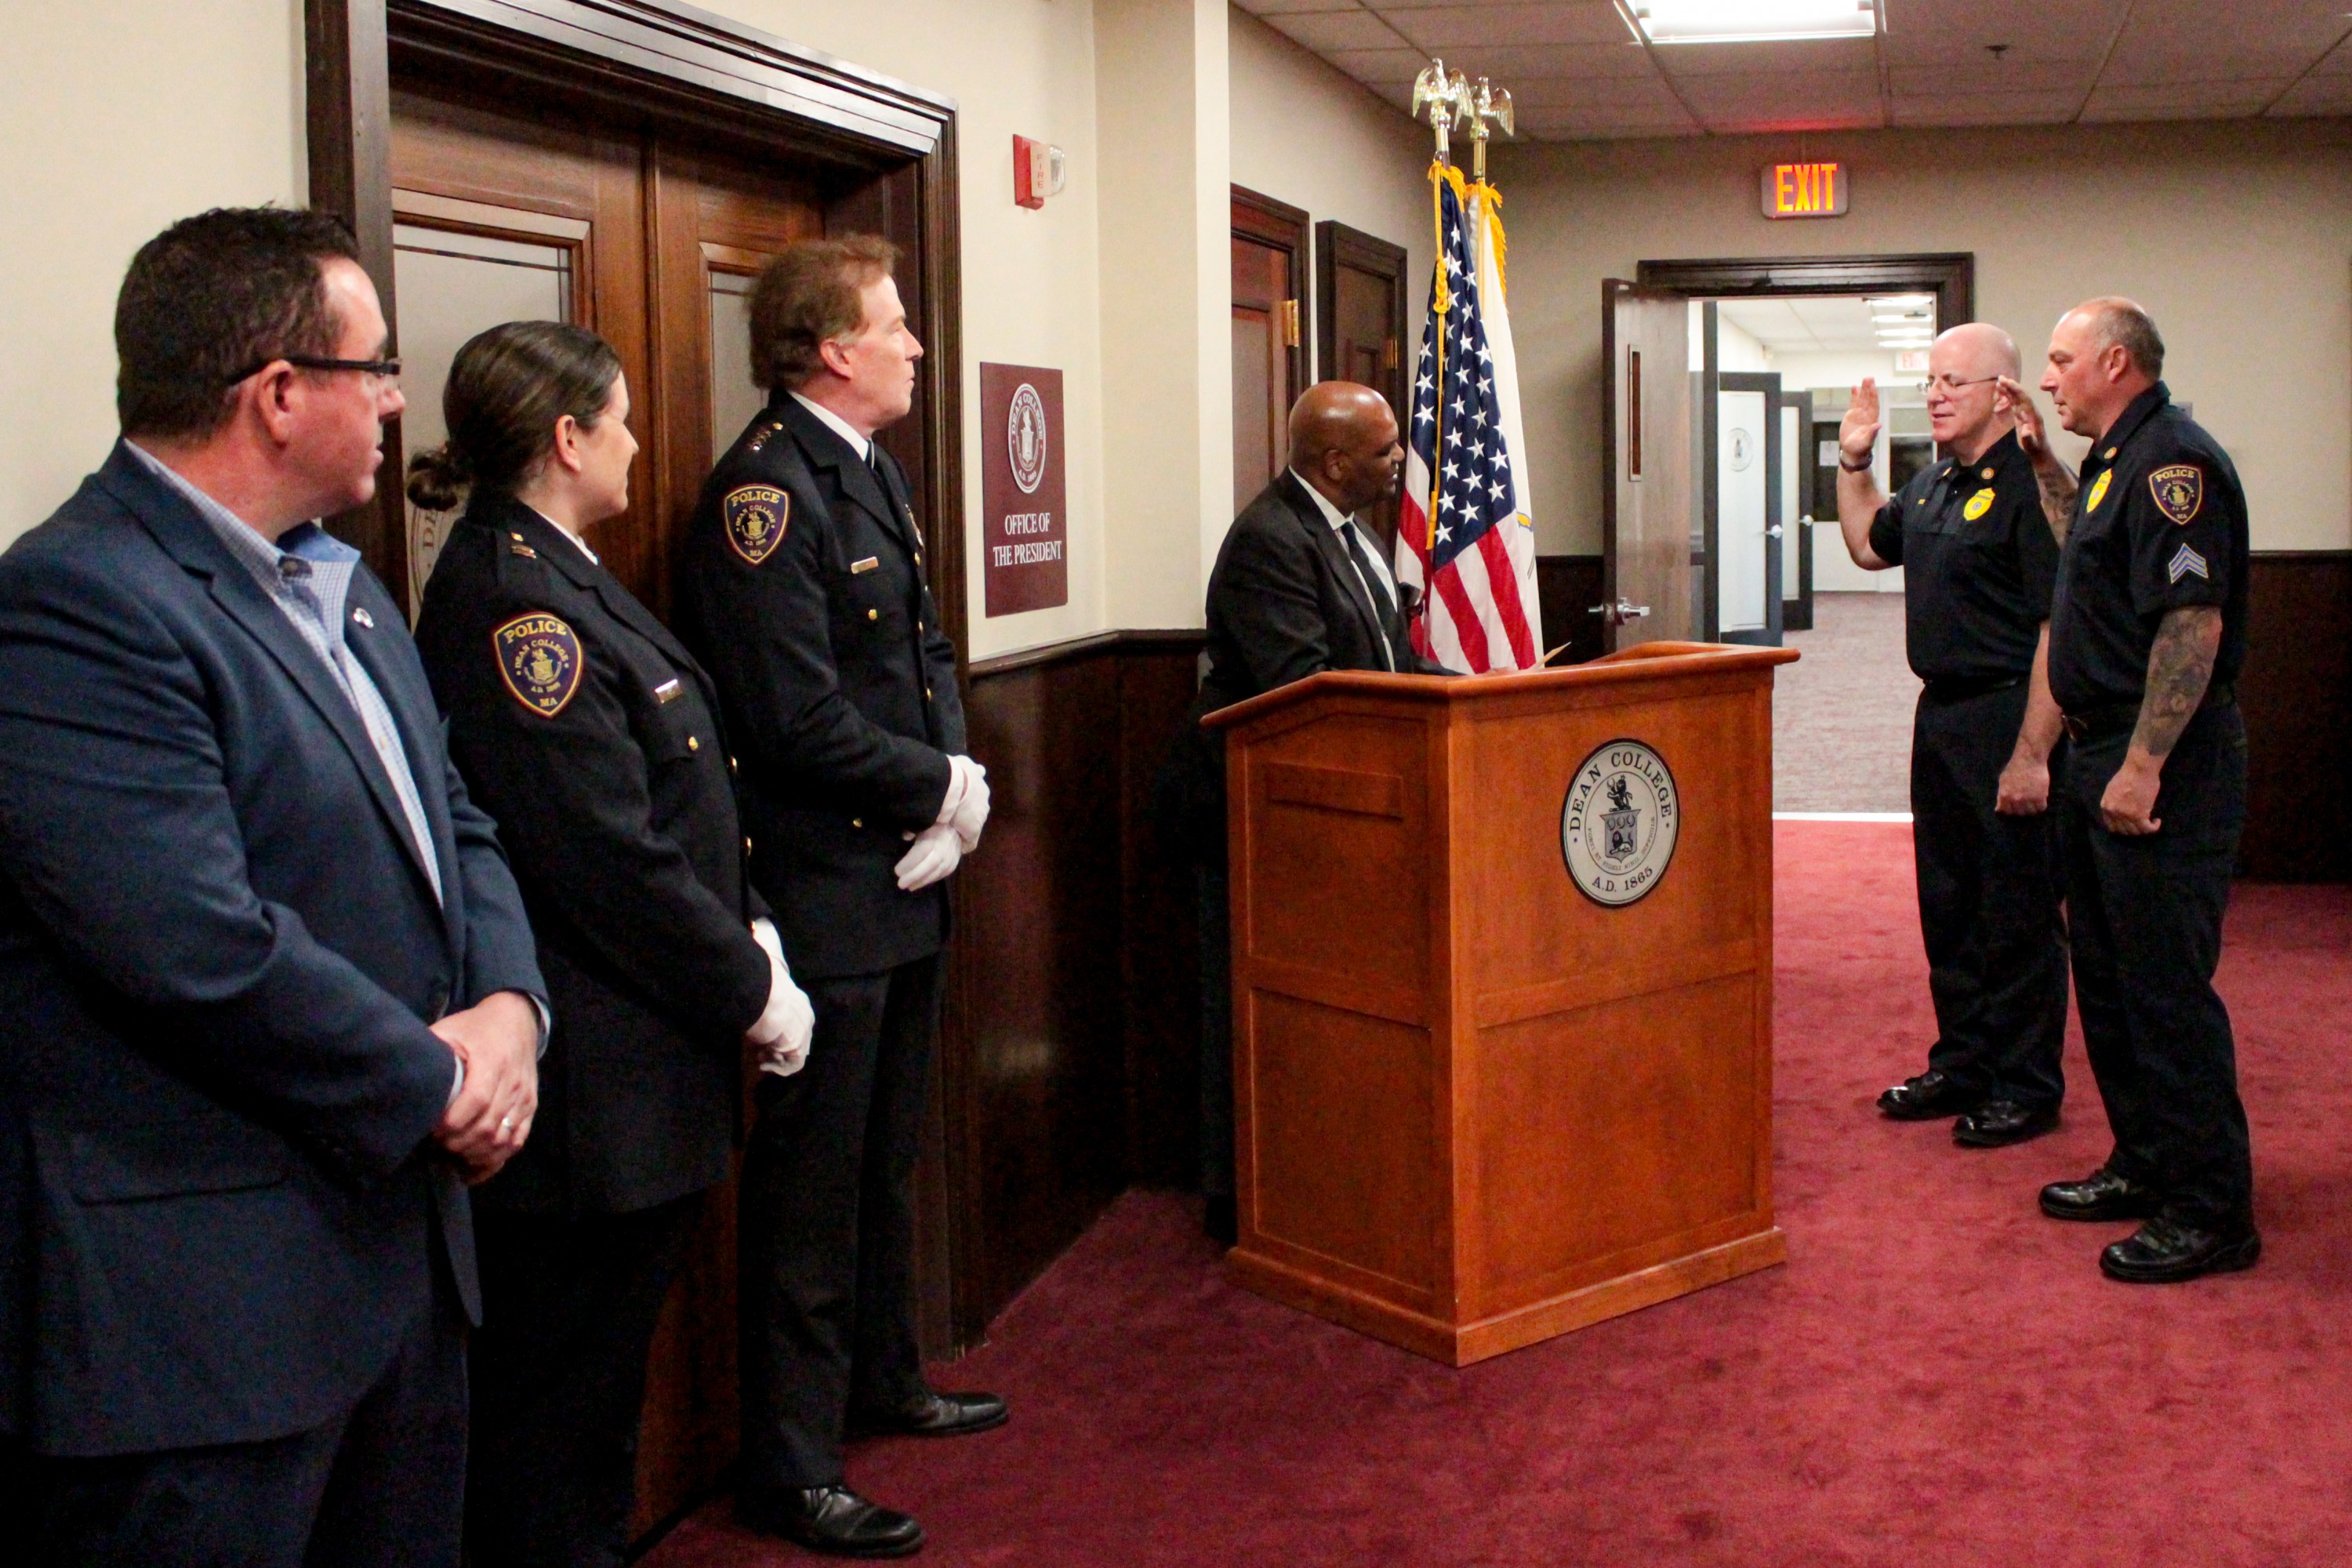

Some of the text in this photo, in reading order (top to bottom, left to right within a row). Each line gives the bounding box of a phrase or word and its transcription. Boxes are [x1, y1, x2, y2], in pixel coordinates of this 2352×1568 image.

[1775, 163, 1838, 212] EXIT
[1011, 393, 1044, 440] DEAN COLLEGE
[2155, 469, 2195, 482] POLICE
[731, 491, 780, 507] POLICE
[1004, 512, 1051, 535] OFFICE OF
[993, 540, 1062, 567] THE PRESIDENT
[503, 620, 567, 644] POLICE
[531, 639, 569, 662] COLLEGE
[539, 697, 557, 707] MA
[1570, 751, 1671, 832] DEAN COLLEGE
[1592, 866, 1653, 892] A.D. 1865
